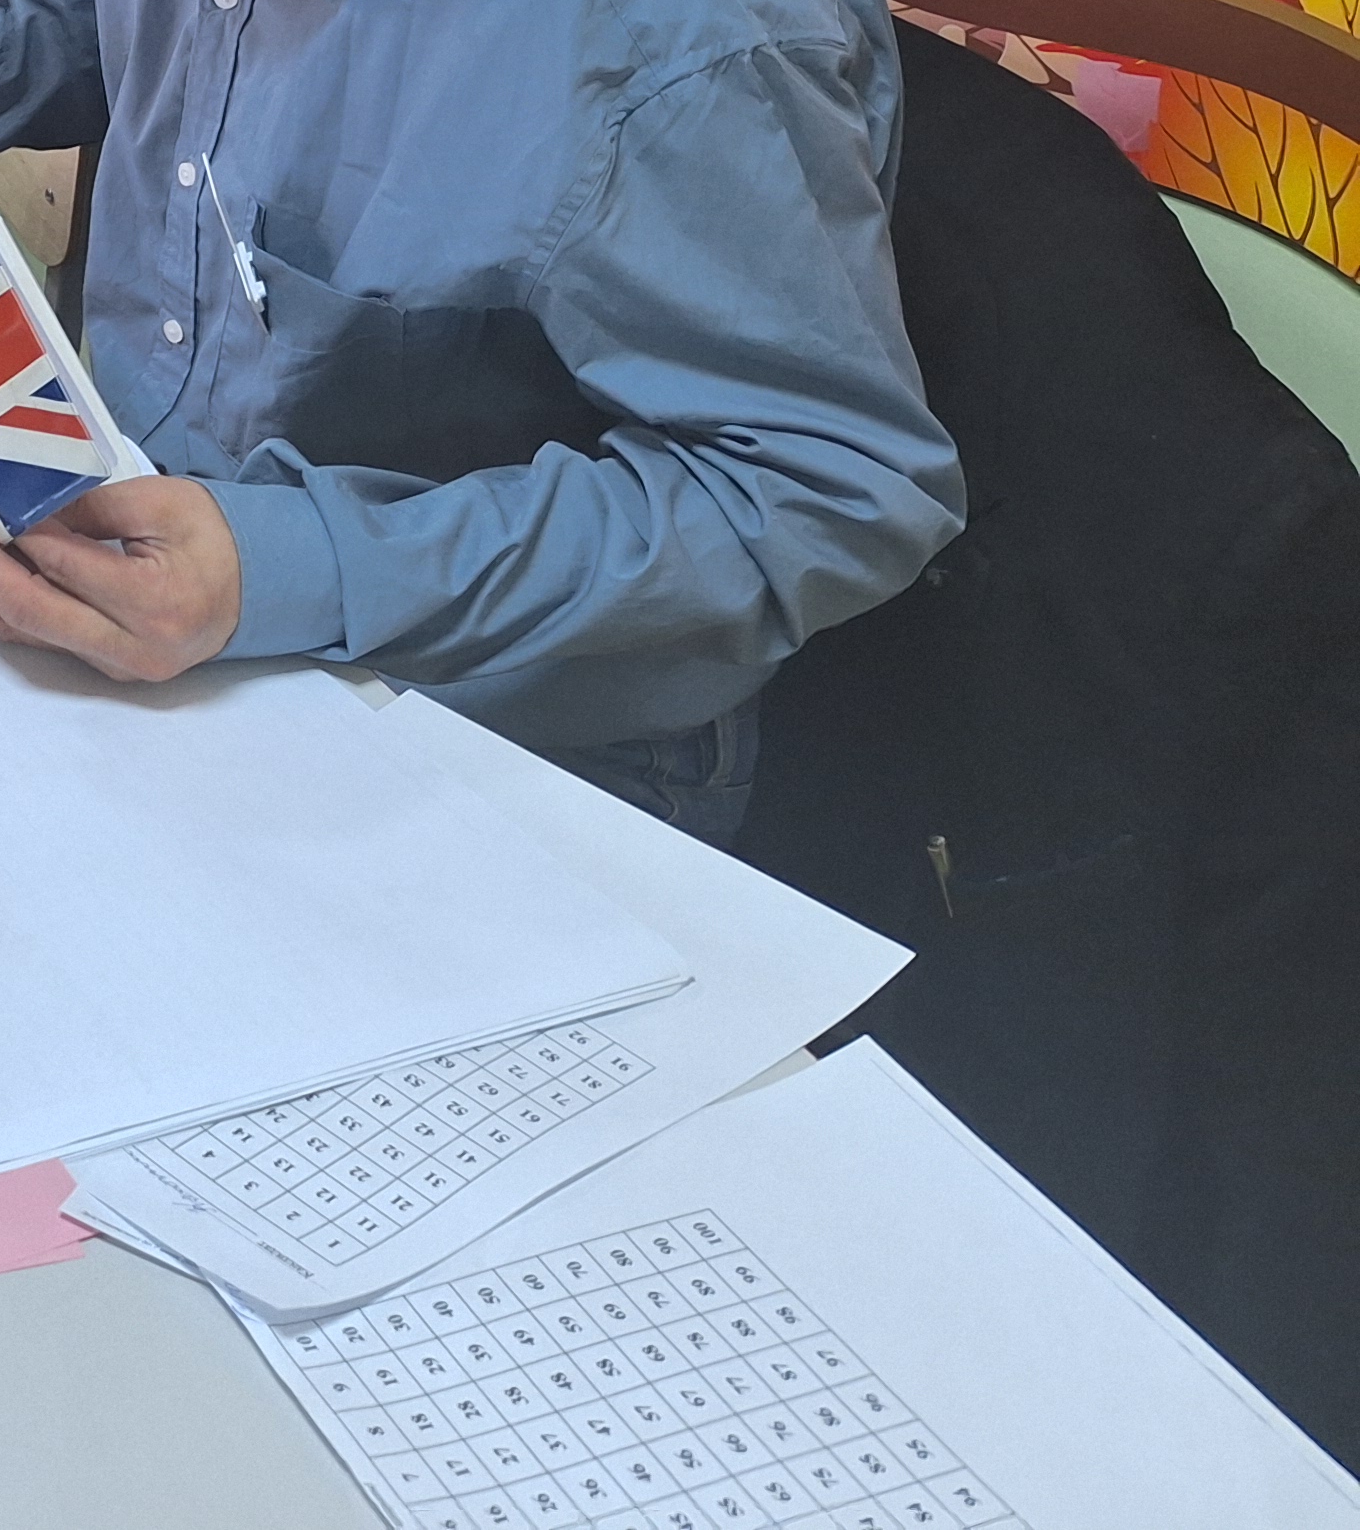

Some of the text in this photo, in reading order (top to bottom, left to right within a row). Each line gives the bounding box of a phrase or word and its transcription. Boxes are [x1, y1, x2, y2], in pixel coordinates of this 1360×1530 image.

[568, 1030, 632, 1072] 91 92
[538, 1047, 603, 1090] 81 82
[433, 1055, 541, 1123] 61 62 63
[507, 1064, 571, 1107] 71 72
[371, 1093, 393, 1108] 43
[403, 1073, 511, 1144] 51 52 53
[414, 1122, 436, 1137] 42
[306, 1136, 330, 1153] 23
[338, 1115, 447, 1188] 31 32 33
[456, 1149, 477, 1164] 41
[231, 1127, 379, 1233] 11 12 13 14
[348, 1165, 373, 1183] 22
[201, 1149, 342, 1249] 1 2 3 4
[390, 1194, 414, 1212] 21
[692, 1222, 723, 1245] 100
[652, 1237, 677, 1255] 90
[609, 1249, 633, 1267] 80
[566, 1260, 589, 1280] 70
[734, 1266, 760, 1284] 99
[522, 1273, 546, 1291] 60
[690, 1279, 716, 1297] 89
[647, 1291, 671, 1309] 79
[603, 1303, 627, 1321] 69
[775, 1306, 801, 1325] 98
[387, 1314, 412, 1332] 30
[558, 1315, 583, 1334] 59
[730, 1318, 757, 1338] 88
[342, 1326, 366, 1344] 20
[686, 1331, 710, 1351] 78
[641, 1344, 666, 1363] 68
[816, 1350, 845, 1368] 97
[421, 1357, 447, 1375] 29
[595, 1358, 622, 1377] 58
[770, 1363, 798, 1381] 87
[375, 1369, 399, 1387] 19
[477, 1287, 652, 1483] 46 47 48 49 50
[725, 1376, 751, 1395] 77
[432, 1300, 608, 1499] 36 37 38 39 40
[679, 1390, 706, 1408] 67
[860, 1393, 886, 1413] 96
[296, 1336, 420, 1483] 7 8 9 10
[457, 1400, 483, 1420] 28
[633, 1405, 662, 1422] 57
[813, 1407, 842, 1427] 86
[410, 1413, 435, 1431] 18
[768, 1420, 793, 1442] 76
[724, 1433, 748, 1454] 66
[905, 1438, 931, 1460] 95
[492, 1447, 520, 1466] 27
[674, 1448, 703, 1470] 56
[858, 1453, 887, 1475] 85
[445, 1460, 472, 1477] 17
